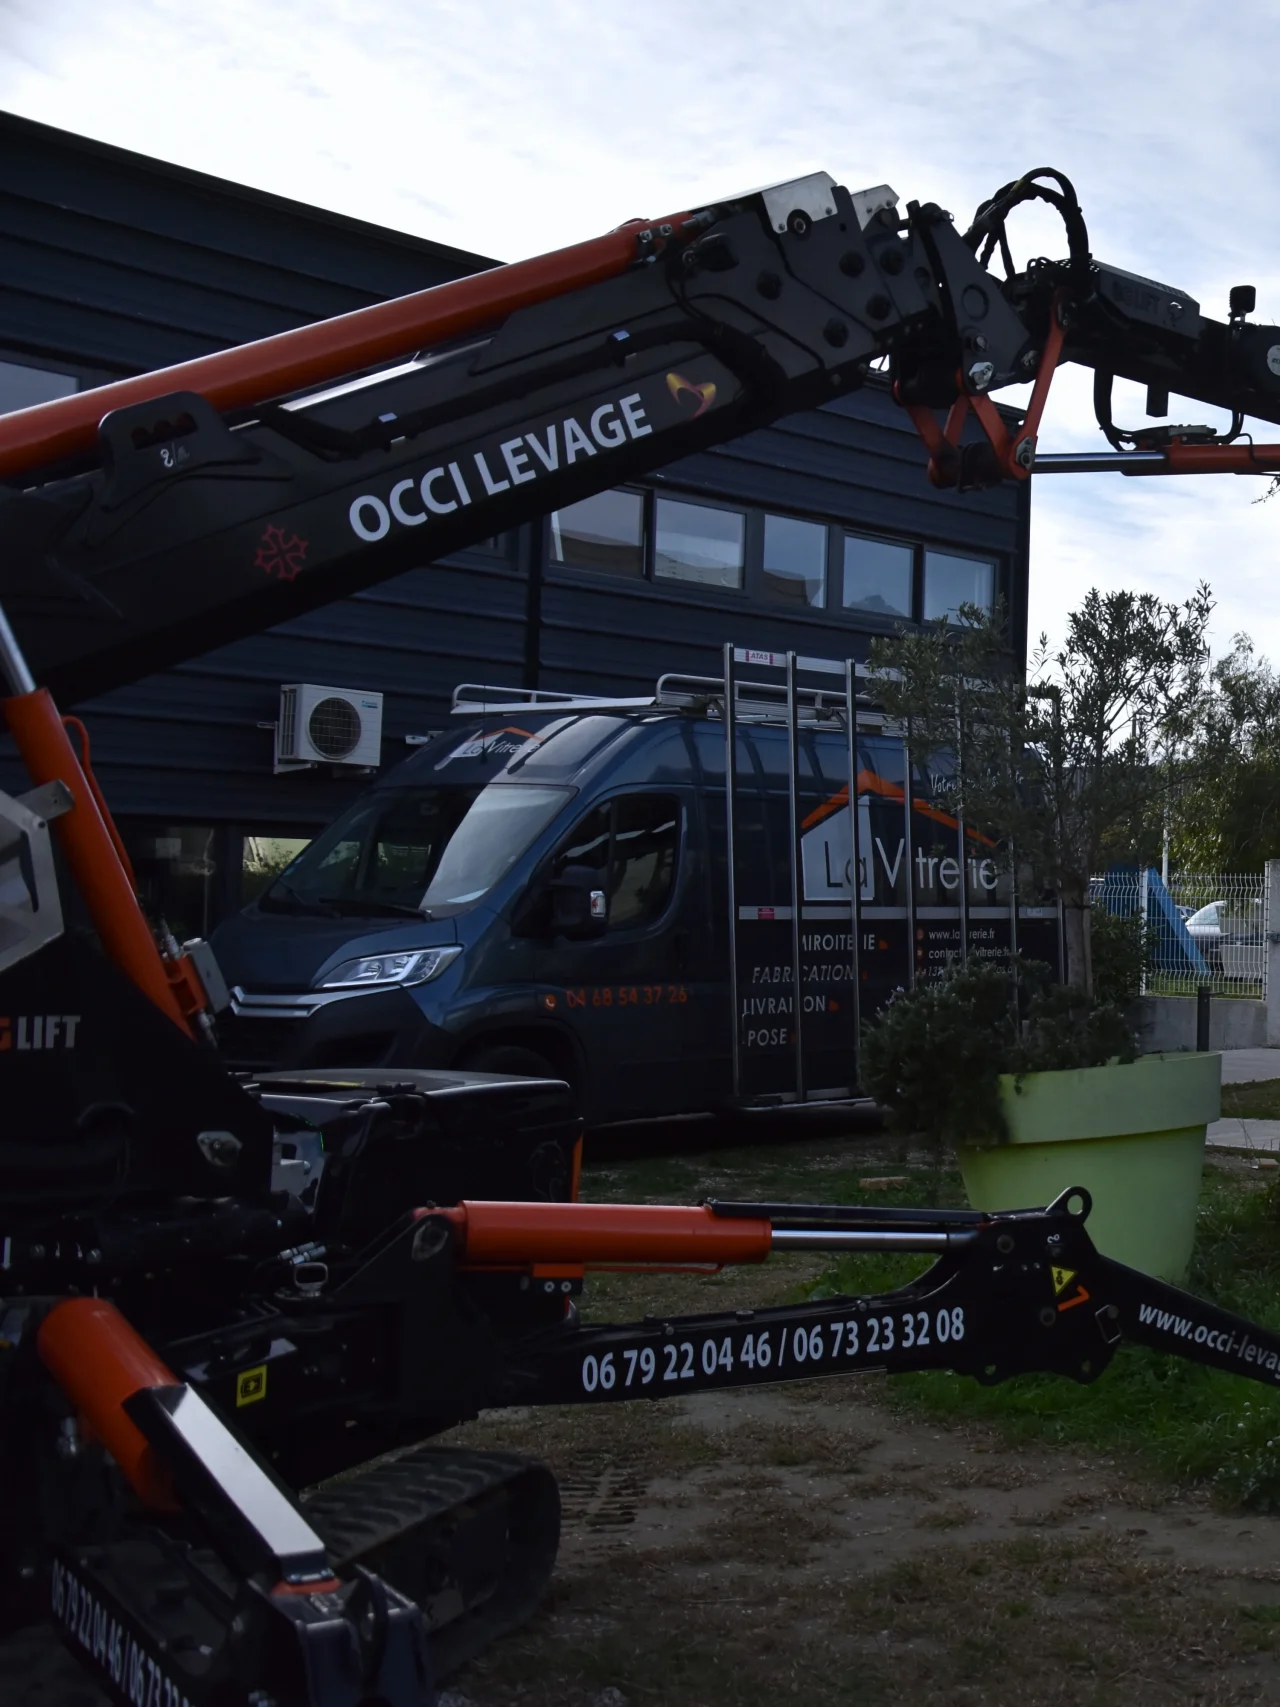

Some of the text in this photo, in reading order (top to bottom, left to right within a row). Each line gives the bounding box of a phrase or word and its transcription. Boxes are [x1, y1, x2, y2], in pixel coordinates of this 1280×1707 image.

[349, 393, 653, 543] OCCI LEVAGE
[825, 837, 999, 890] La Vtreie
[801, 934, 876, 951] IROITEIE
[566, 984, 688, 1008] 04 68 54 37 26
[743, 995, 826, 1016] LIVRAION
[17, 1015, 82, 1051] LIFT
[748, 1028, 788, 1047] POSE
[582, 1306, 965, 1393] 06 79 22 04 46 / 06 73 23 32 08
[52, 1556, 65, 1619] 06
[65, 1570, 79, 1633] 79
[78, 1583, 93, 1652] 22
[93, 1600, 108, 1669] 04
[108, 1617, 124, 1684] 46
